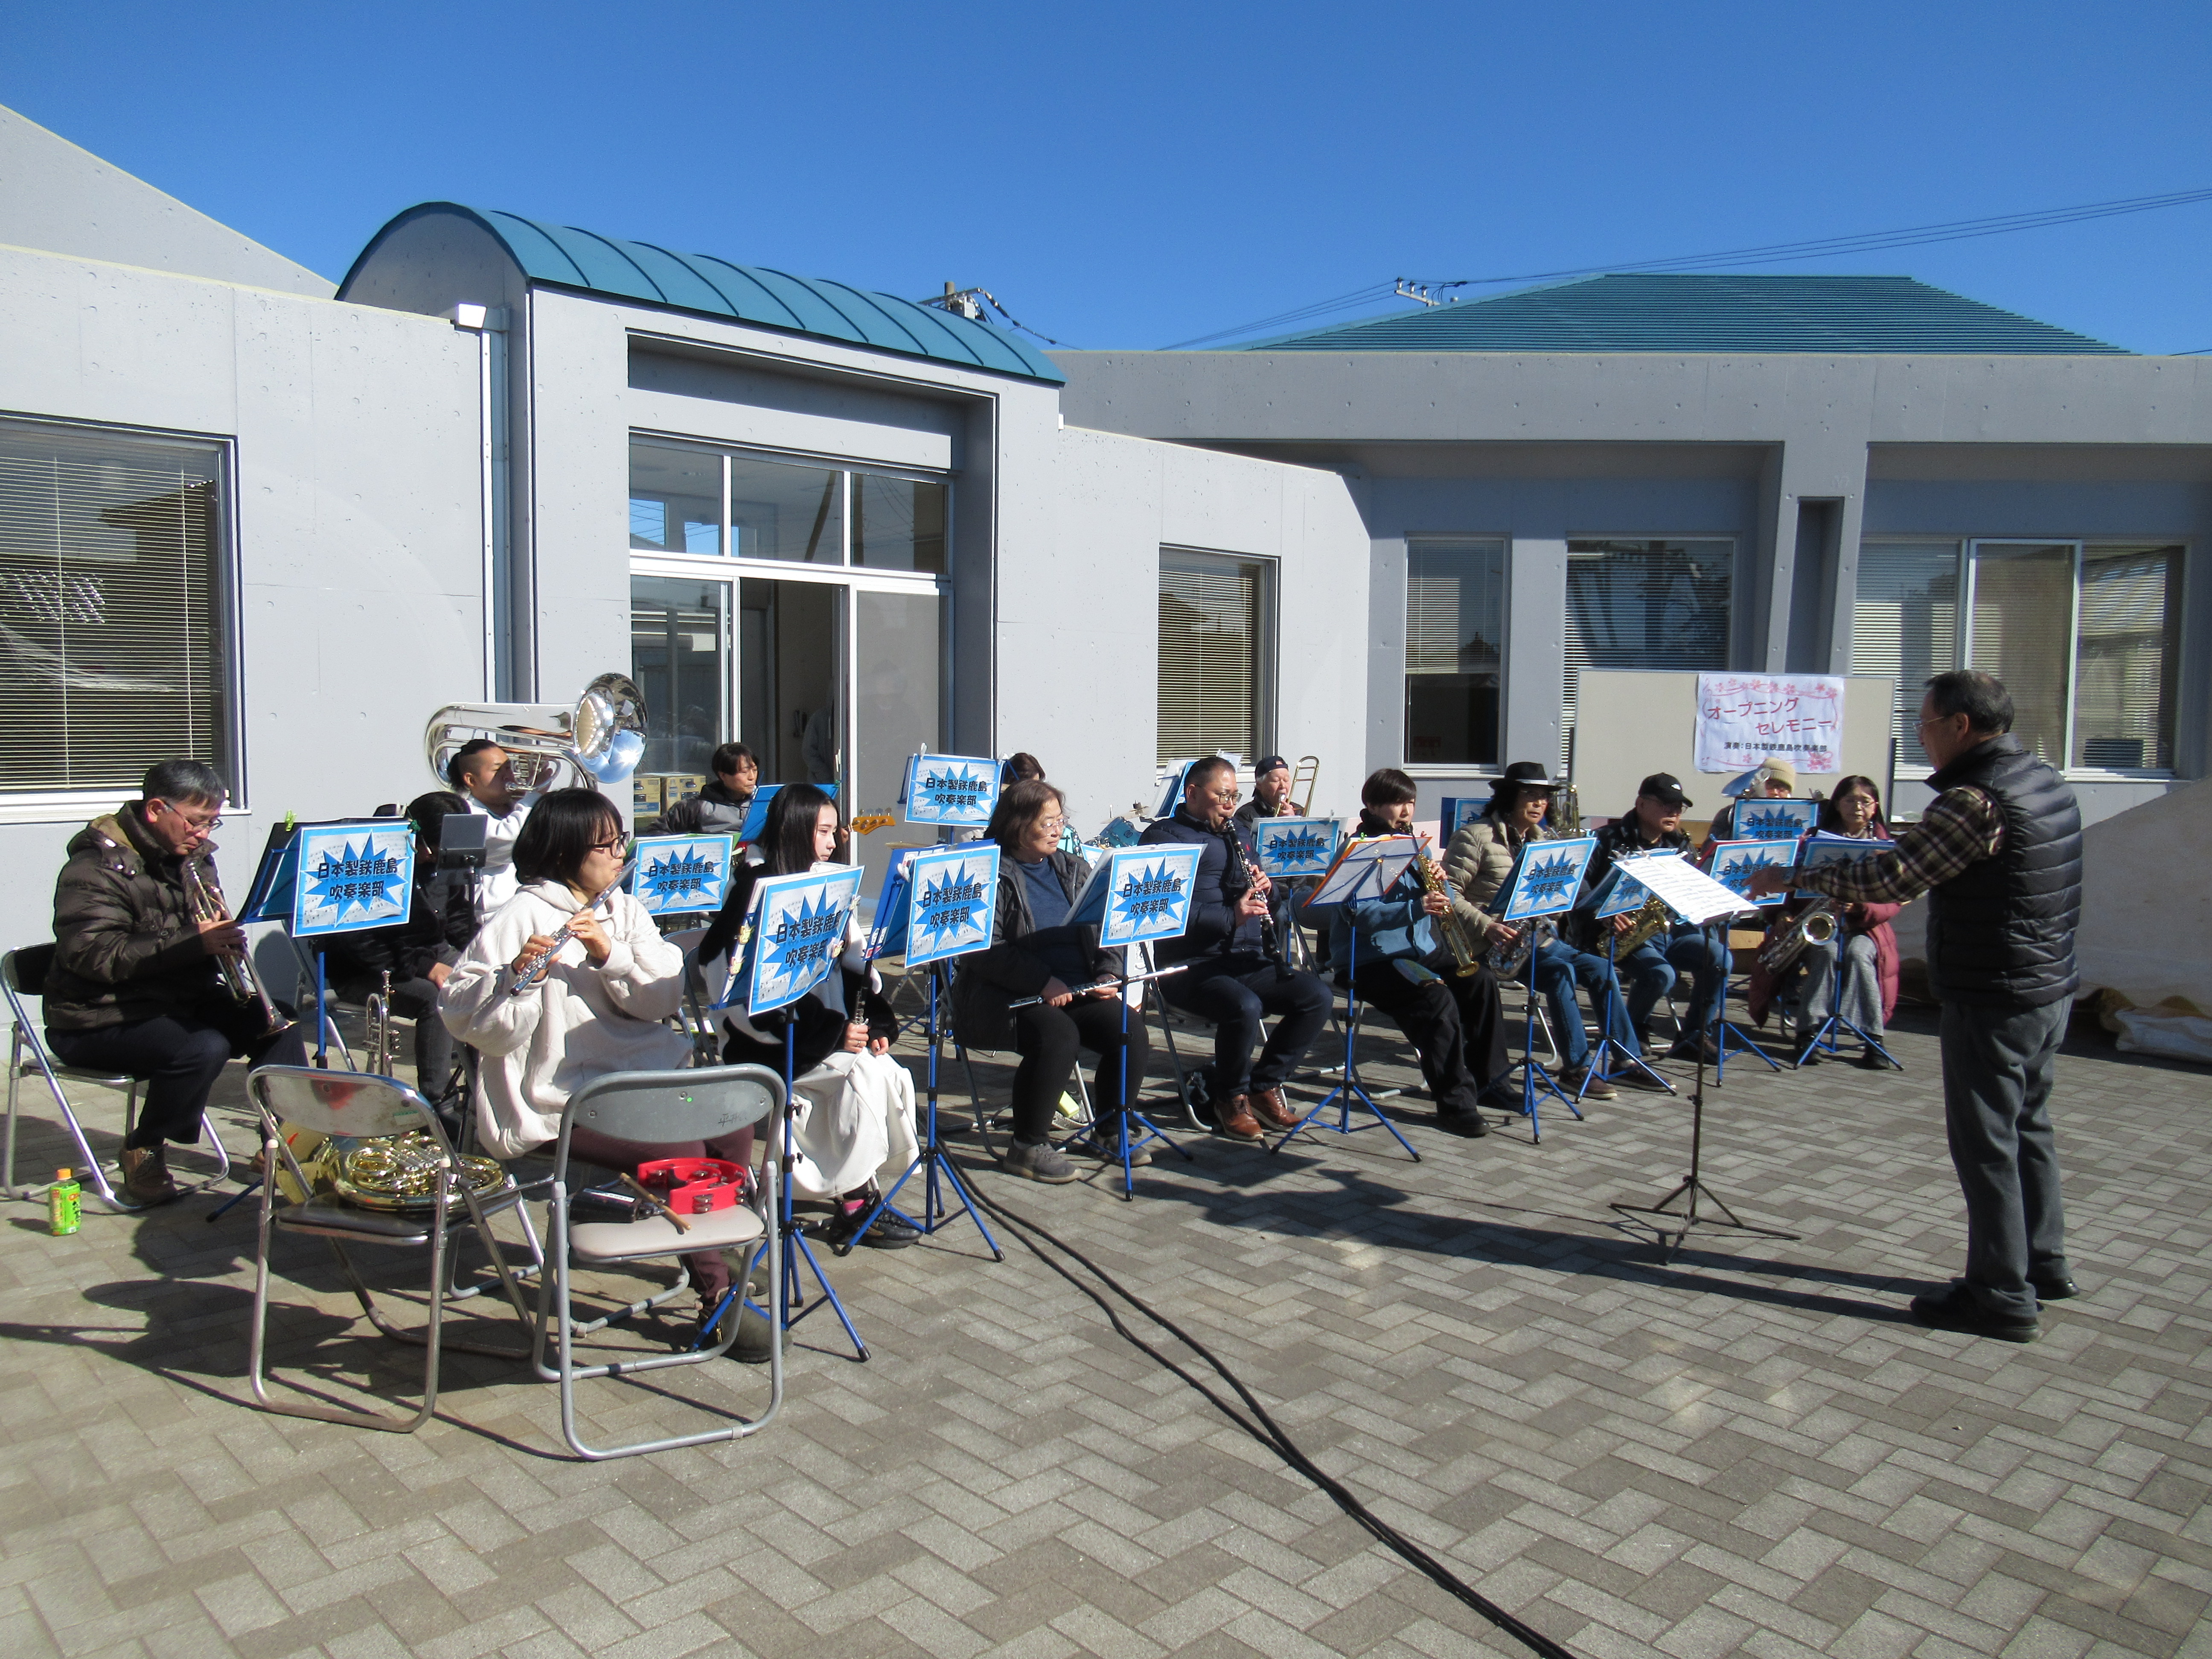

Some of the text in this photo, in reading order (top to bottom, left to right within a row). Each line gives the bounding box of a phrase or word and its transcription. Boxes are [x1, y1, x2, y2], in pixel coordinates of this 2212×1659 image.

[1708, 697, 1799, 720] オープニング
[1755, 718, 1832, 735] セレモニー
[925, 777, 987, 792] 日本製鉄鹿島
[934, 794, 977, 806] 吹奏楽部
[1270, 837, 1324, 849] 日本製鉄鹿島
[1278, 850, 1314, 860] 吹奏楽部
[318, 857, 398, 879] 日本製鉄鹿島
[649, 861, 714, 877] 日本製鉄鹿島
[329, 880, 385, 900] 吹奏楽部
[657, 878, 702, 892] 吹奏楽部
[1123, 878, 1182, 897] 日本製鉄鹿島
[923, 882, 982, 908] 日本製鉄鹿島
[1130, 898, 1169, 916] 吹奏楽部
[930, 906, 970, 929] 吹奏楽部
